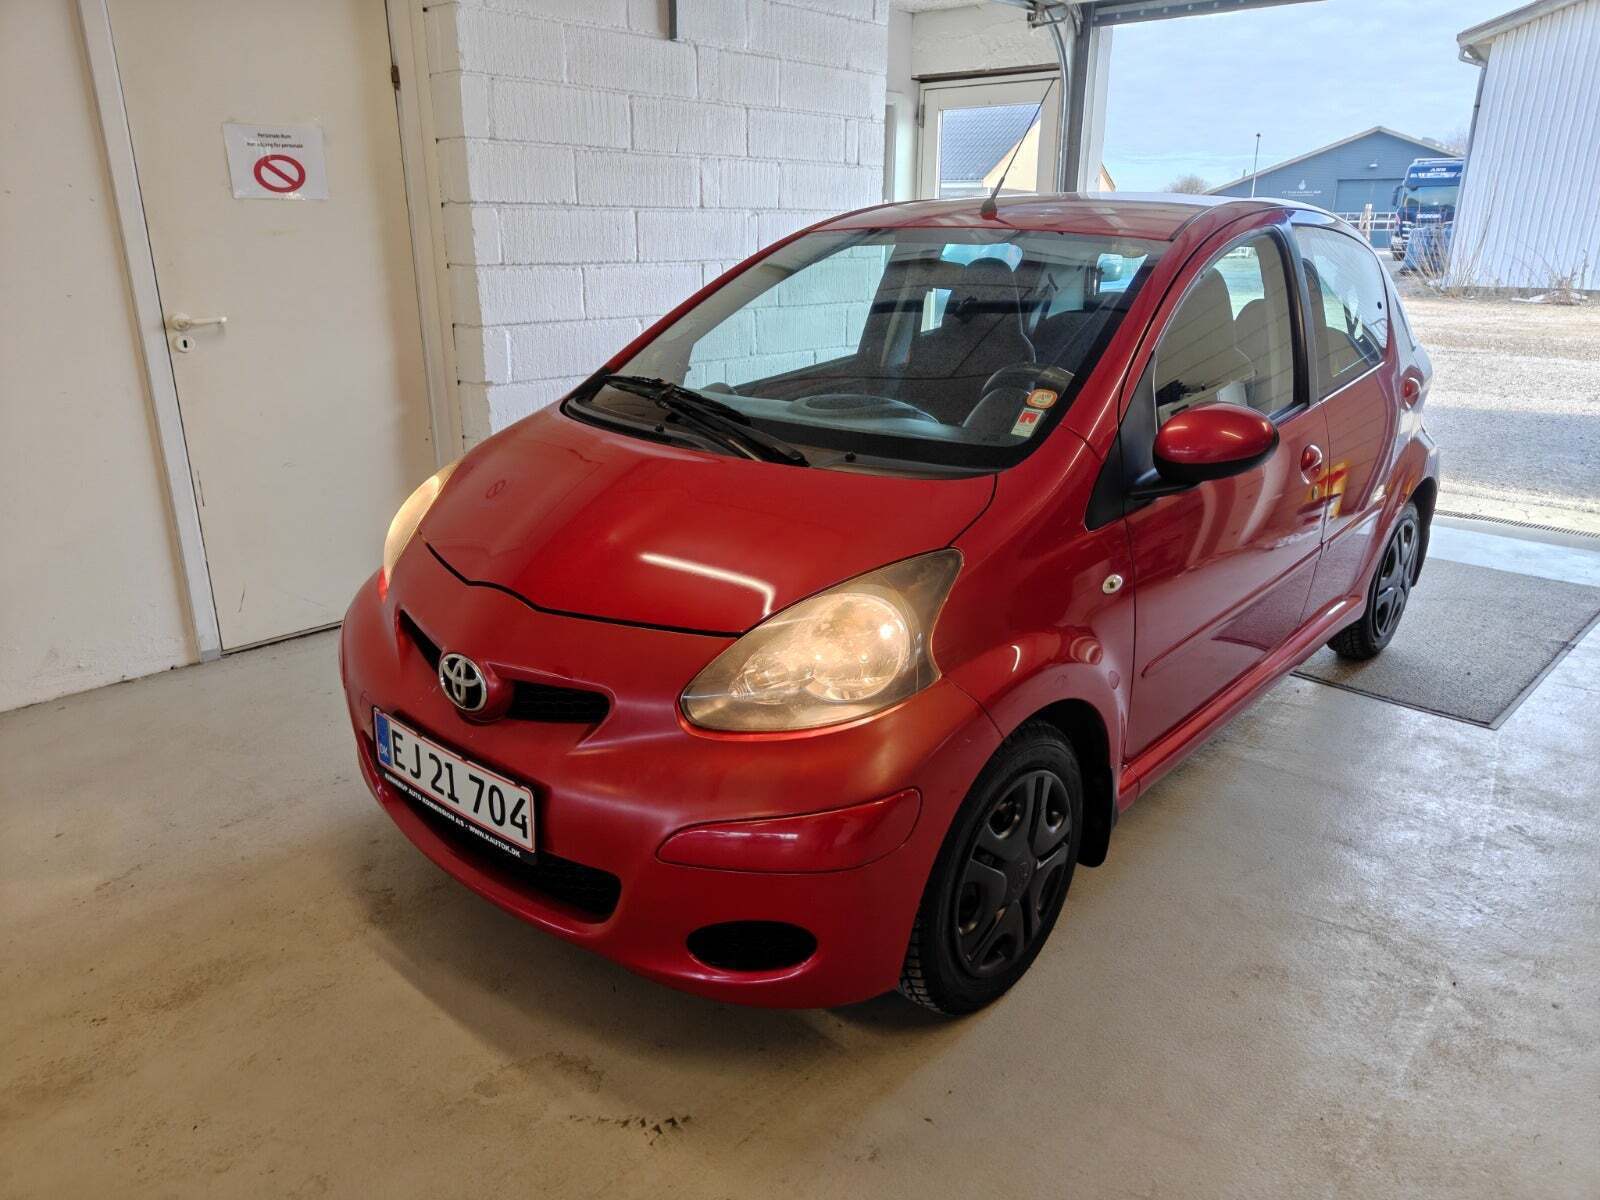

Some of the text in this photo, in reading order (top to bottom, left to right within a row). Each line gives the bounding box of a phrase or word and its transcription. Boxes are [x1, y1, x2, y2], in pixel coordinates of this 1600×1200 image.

[391, 729, 528, 839] EJ 21 704
